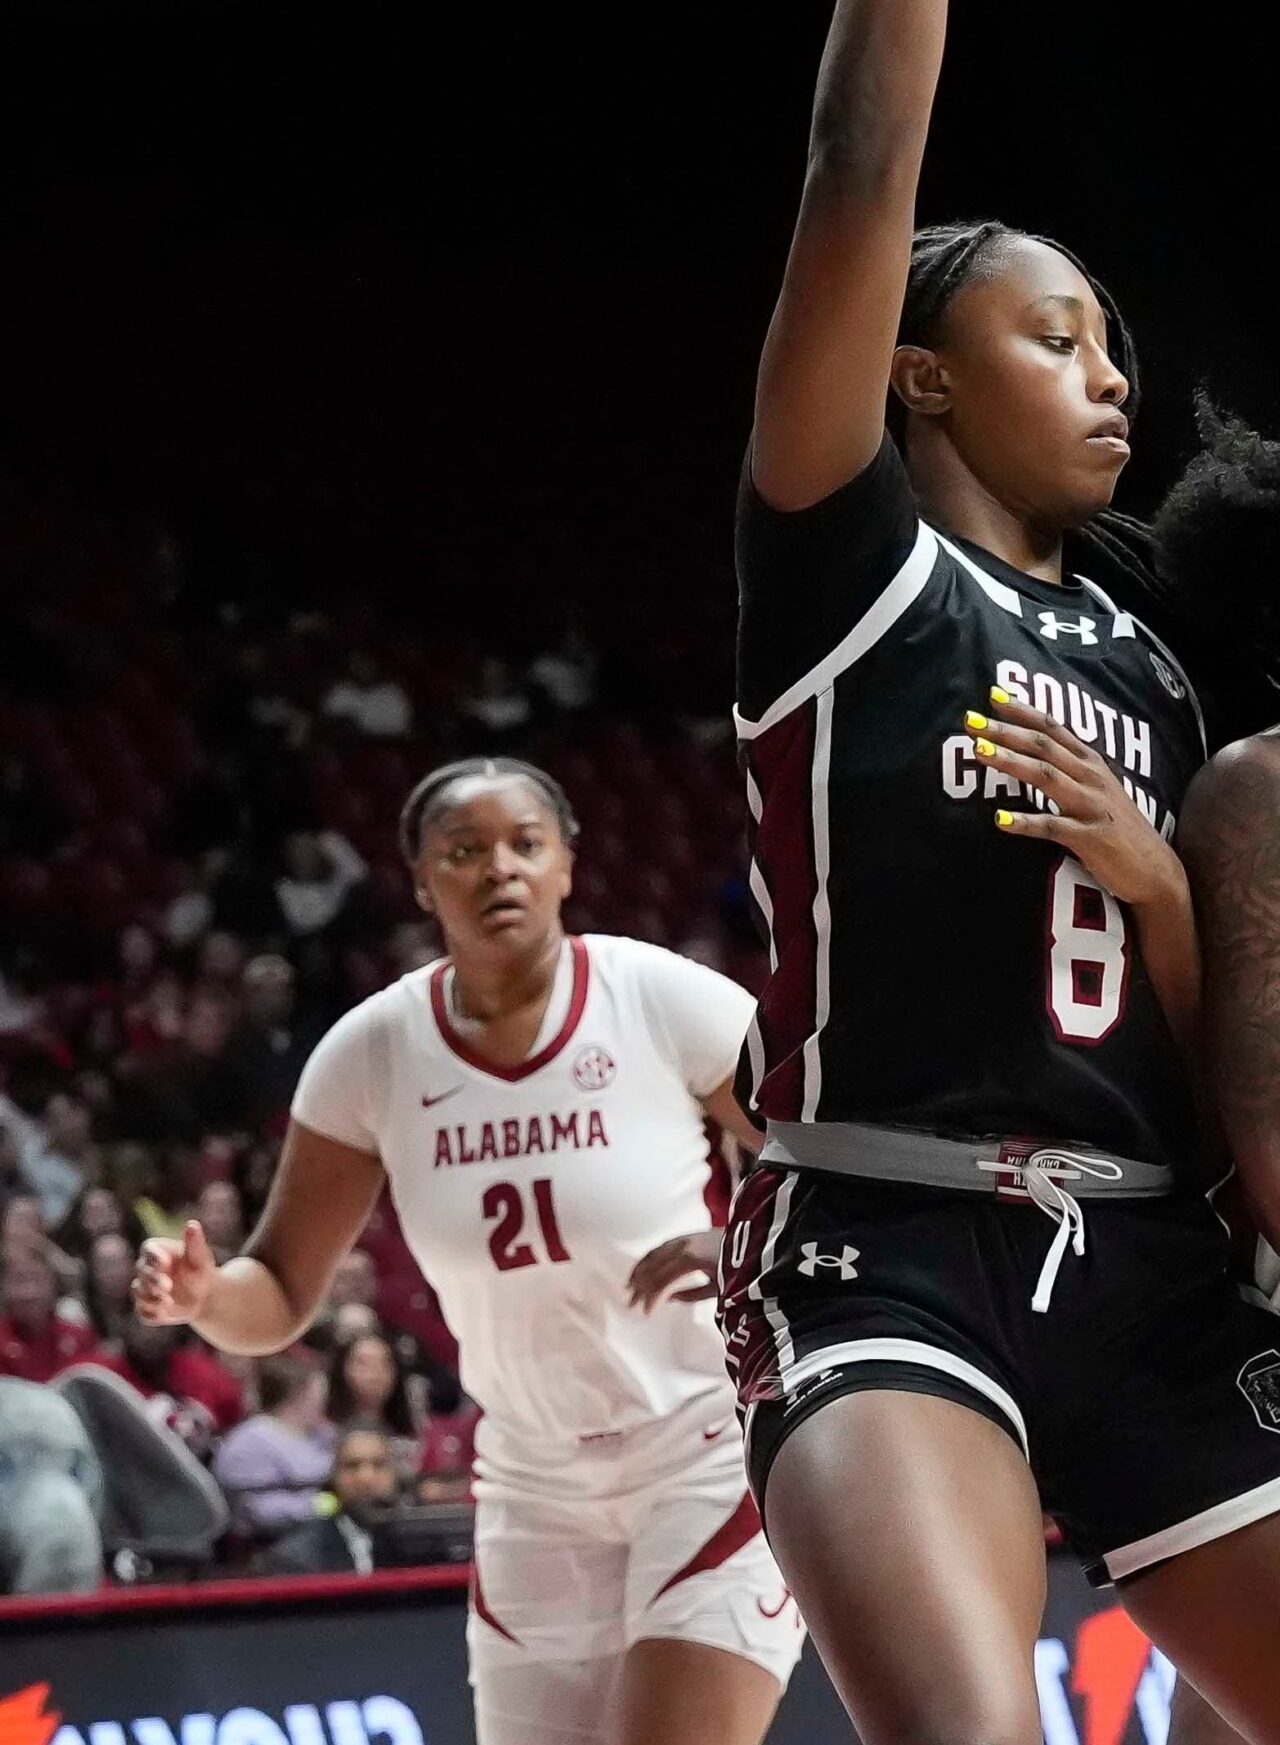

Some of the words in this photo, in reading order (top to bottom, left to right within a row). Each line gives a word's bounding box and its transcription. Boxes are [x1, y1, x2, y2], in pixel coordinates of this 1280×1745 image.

[996, 659, 1151, 778] SOUTH
[1047, 855, 1129, 1044] 8
[434, 1111, 608, 1168] ALABAMA
[482, 1179, 571, 1271] 21
